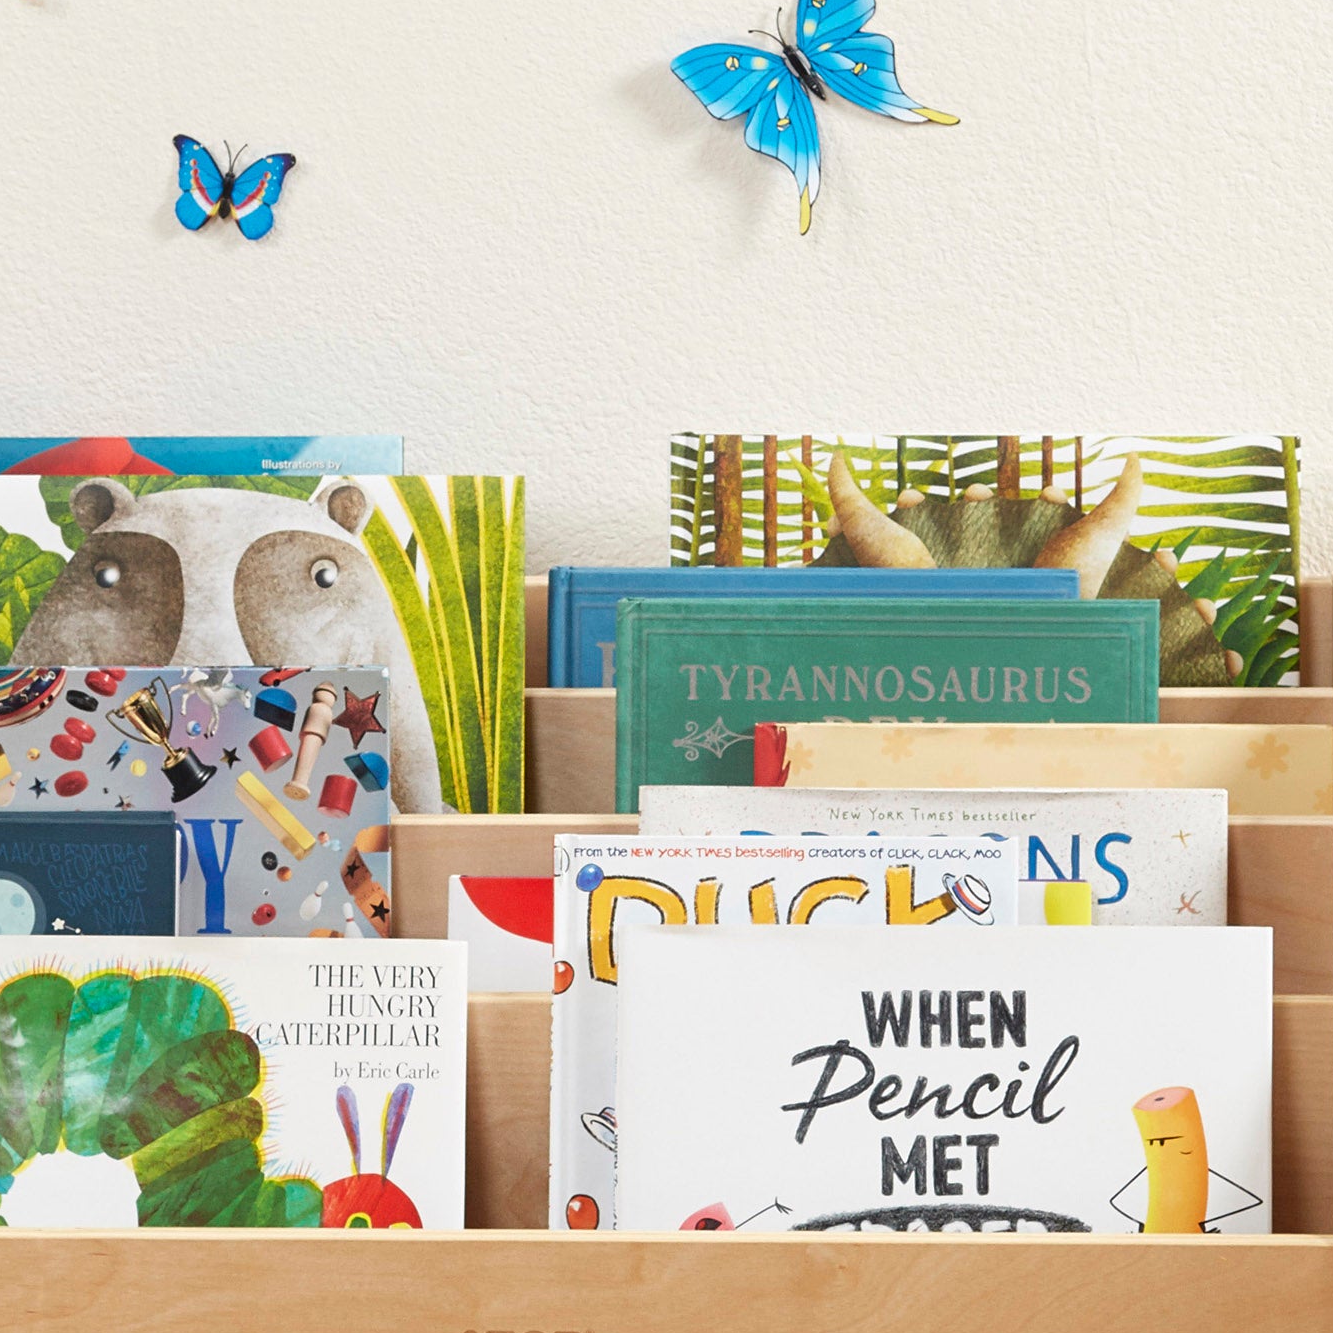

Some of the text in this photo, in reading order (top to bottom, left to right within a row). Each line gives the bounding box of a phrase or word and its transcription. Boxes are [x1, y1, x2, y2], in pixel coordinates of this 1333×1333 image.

[261, 459, 343, 470] Illustrations by
[679, 665, 1092, 704] TYRANNOSAURUS
[830, 808, 1038, 822] NEW YORK TIMES bestseller
[573, 847, 1002, 861] From the NEW YORK TIMES bestselling creators of CLICK, CLACK, MOO
[309, 964, 443, 989] THE VERY
[327, 994, 442, 1018] HUNGRY
[861, 989, 1027, 1049] WHEN
[256, 1022, 441, 1047] CATERPILLAR
[334, 1061, 440, 1084] by Eric Carle
[781, 1035, 1080, 1145] Pencil
[881, 1134, 1000, 1197] MET
